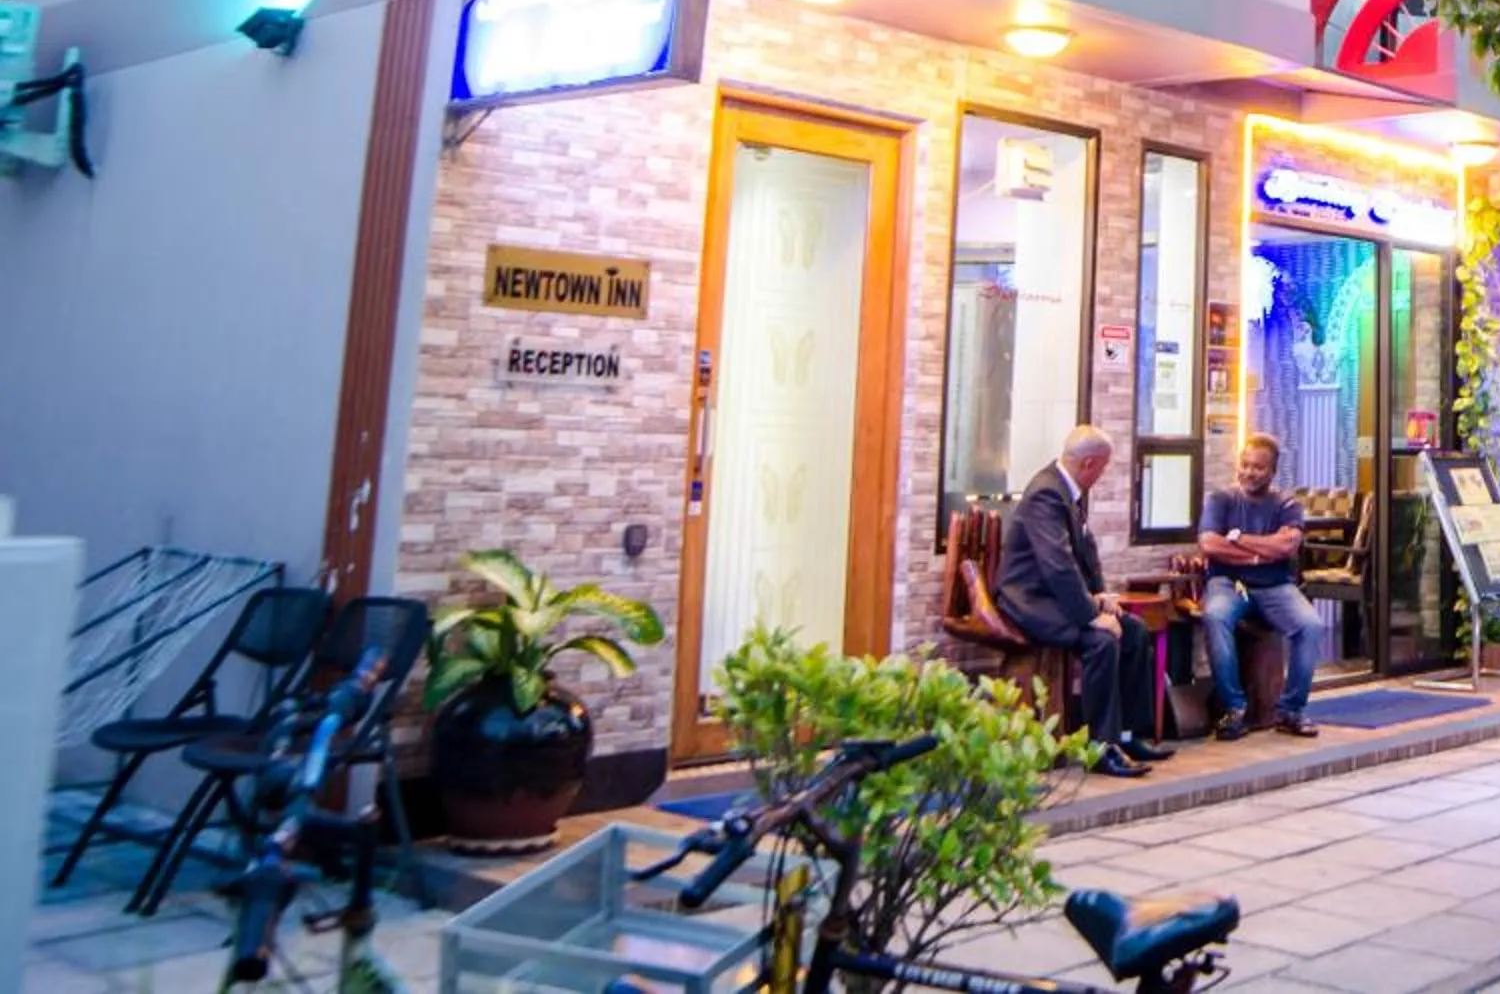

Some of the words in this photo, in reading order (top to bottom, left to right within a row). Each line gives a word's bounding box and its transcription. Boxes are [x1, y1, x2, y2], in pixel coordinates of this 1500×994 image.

[494, 266, 601, 305] NEWTOWN
[608, 275, 641, 308] INN
[508, 349, 619, 378] RECEPTION
